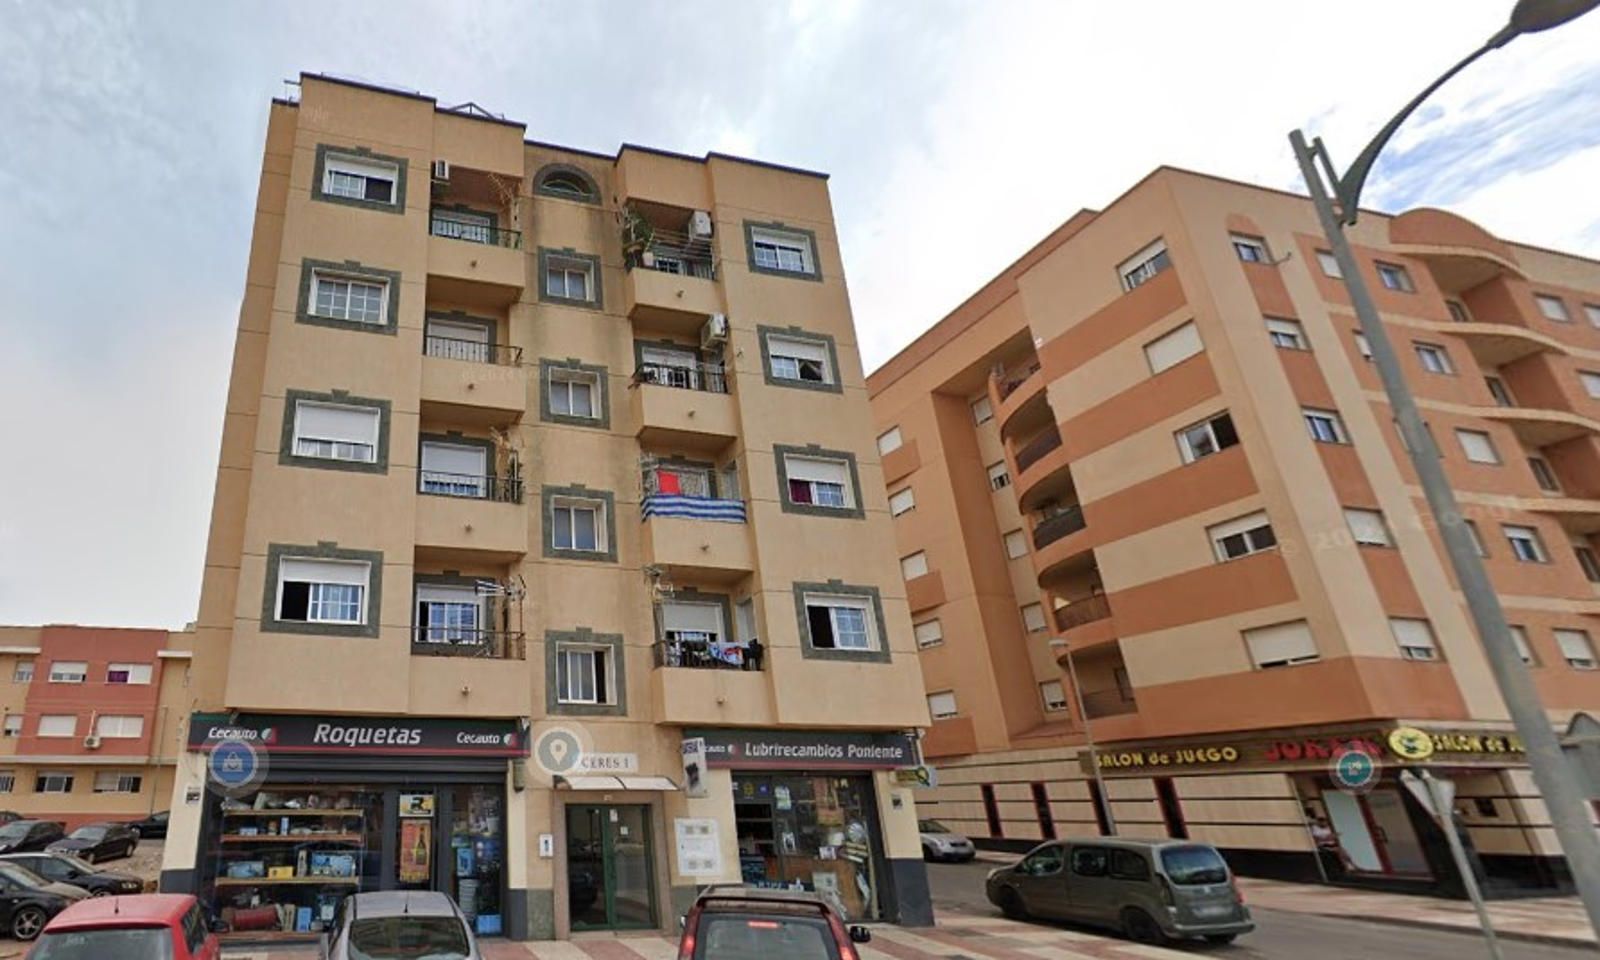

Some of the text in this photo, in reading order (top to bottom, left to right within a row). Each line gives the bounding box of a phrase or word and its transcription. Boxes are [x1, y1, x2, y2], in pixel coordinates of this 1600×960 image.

[208, 727, 258, 740] Cecauto
[313, 724, 422, 747] Roquetas
[456, 732, 500, 744] Cecauto
[745, 742, 904, 758] Lubrirecambios Poniente
[1148, 752, 1169, 764] de
[1175, 747, 1238, 764] JUEGO
[581, 757, 620, 769] CERES
